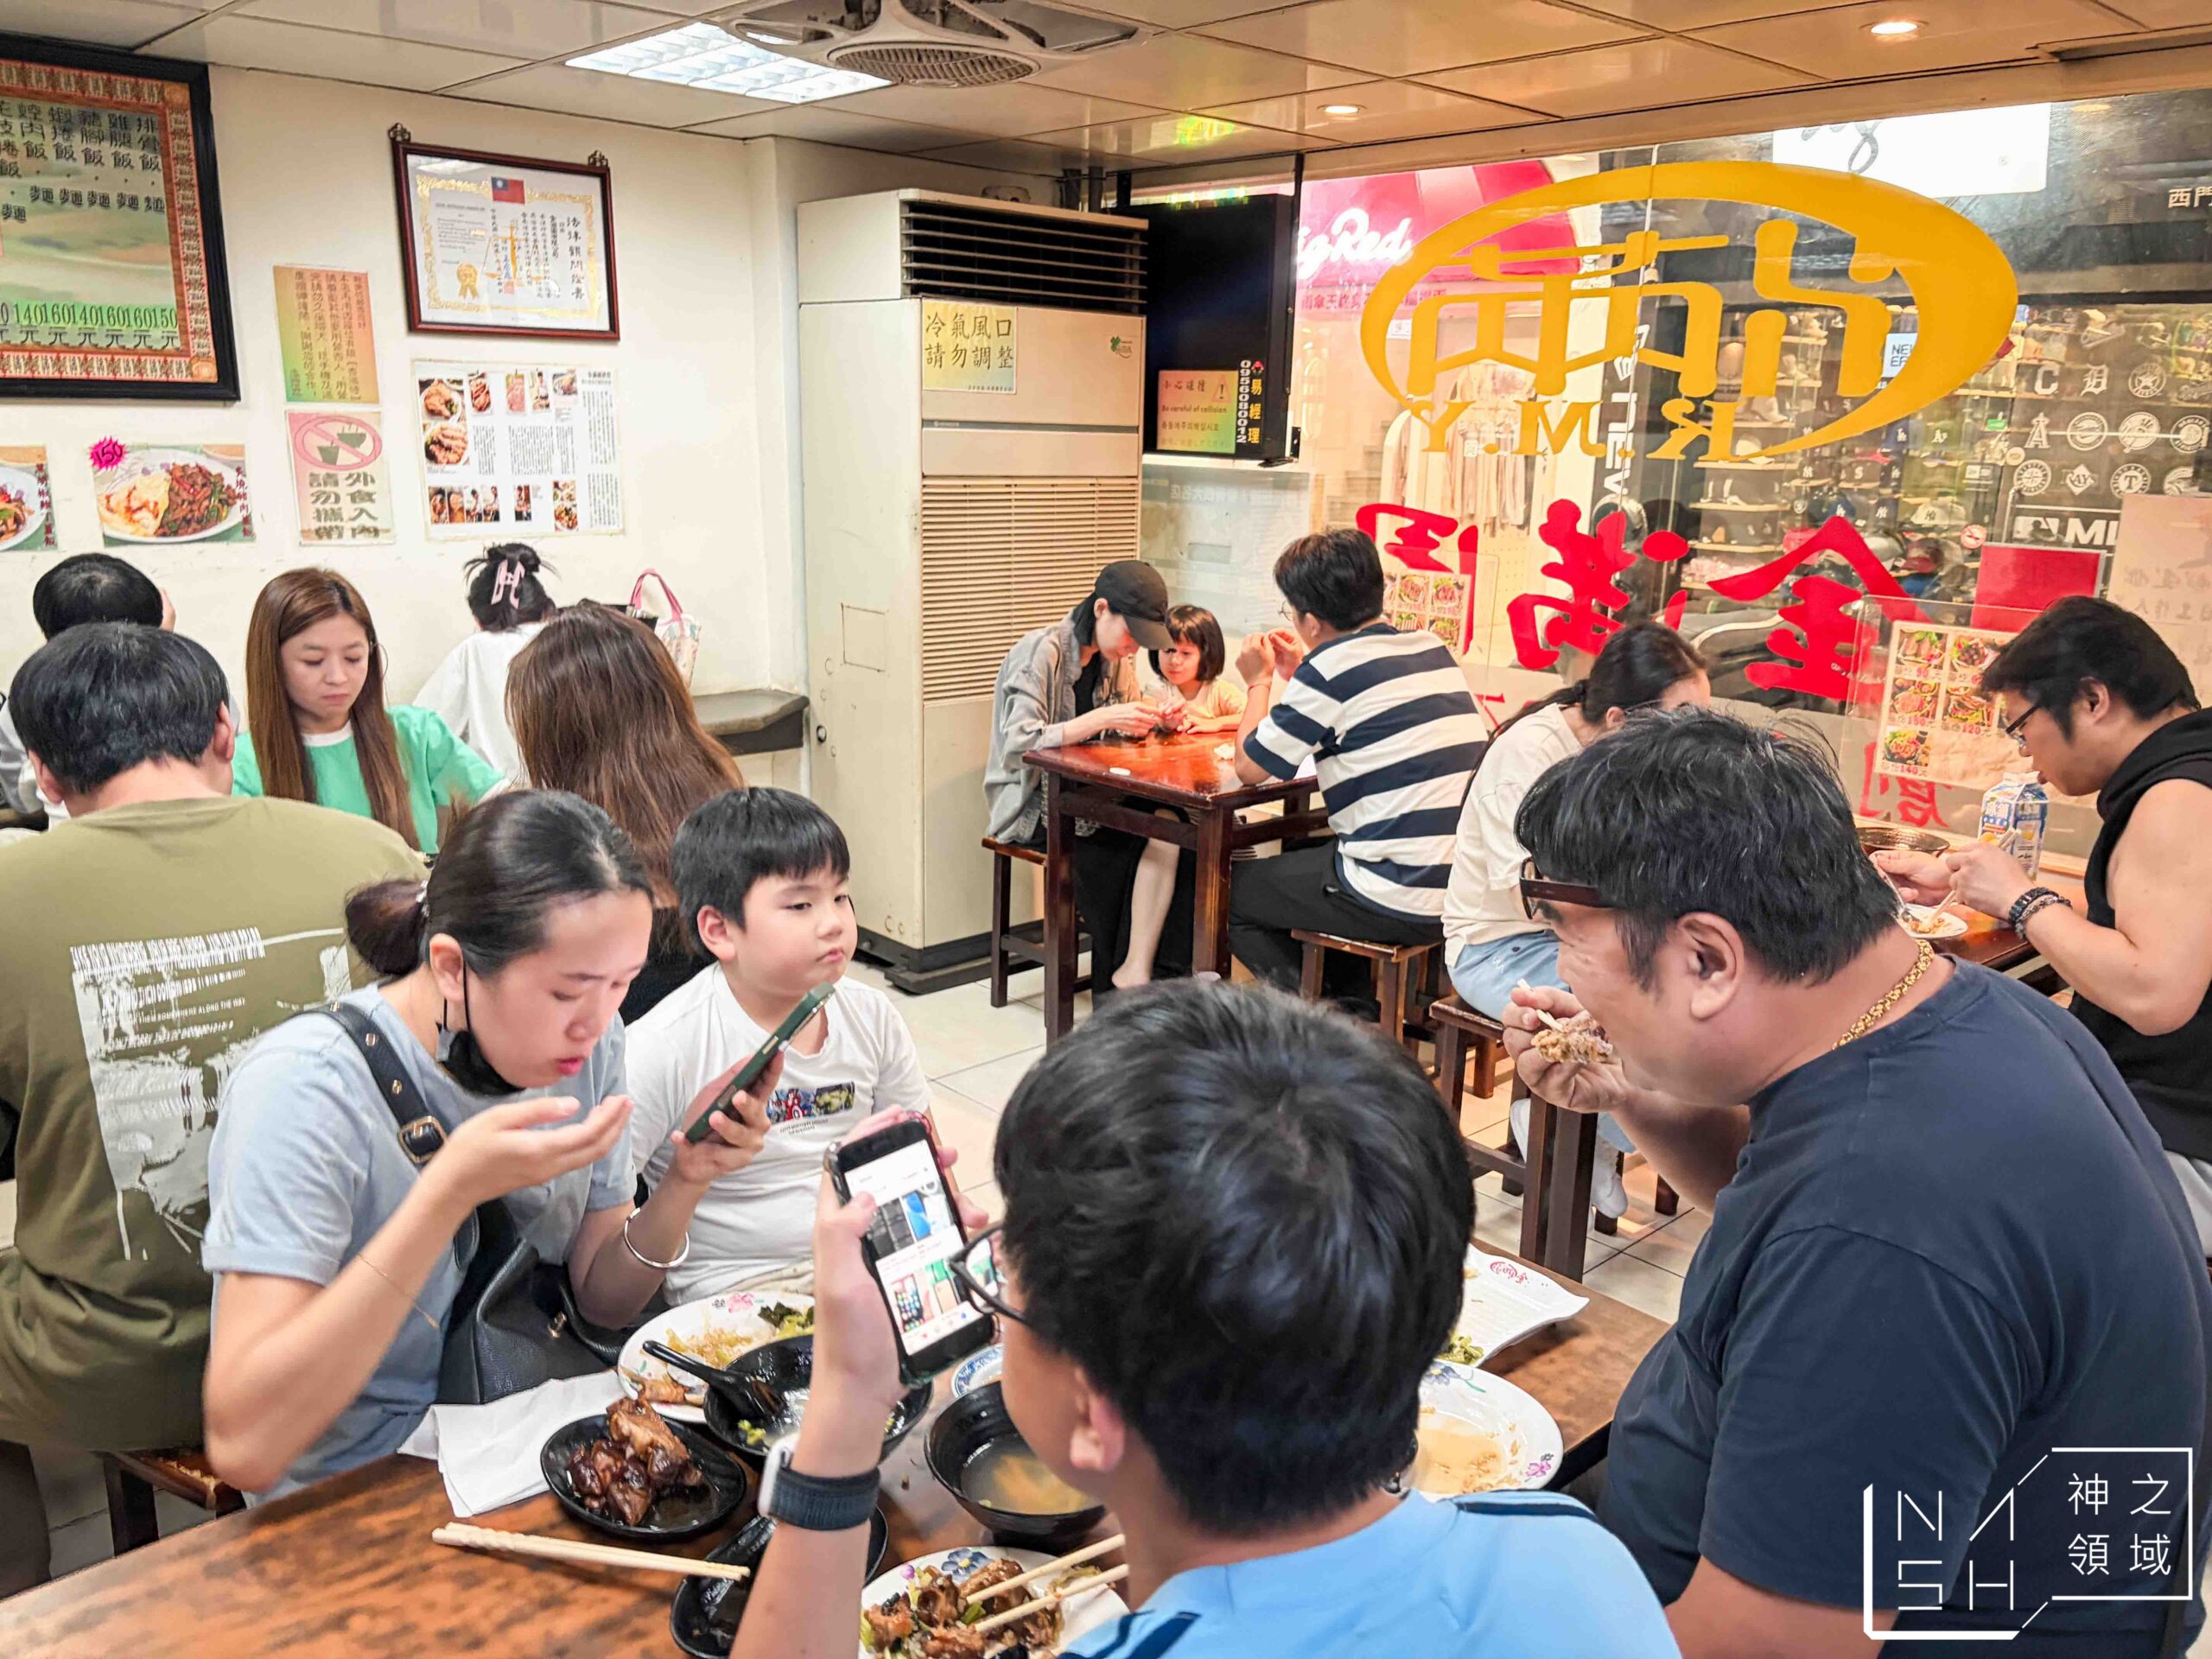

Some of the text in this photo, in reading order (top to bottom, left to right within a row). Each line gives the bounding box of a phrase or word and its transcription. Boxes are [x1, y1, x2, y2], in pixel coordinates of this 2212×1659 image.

[925, 311, 1012, 340] 冷氣風口
[925, 342, 1014, 370] 請勿調整
[1891, 344, 1912, 355] NE
[1236, 359, 1252, 443] 0956080012
[1248, 378, 1263, 443] 易經理
[95, 442, 124, 464] 150
[308, 472, 345, 540] 請勿攜帶
[345, 471, 380, 539] 外食入內
